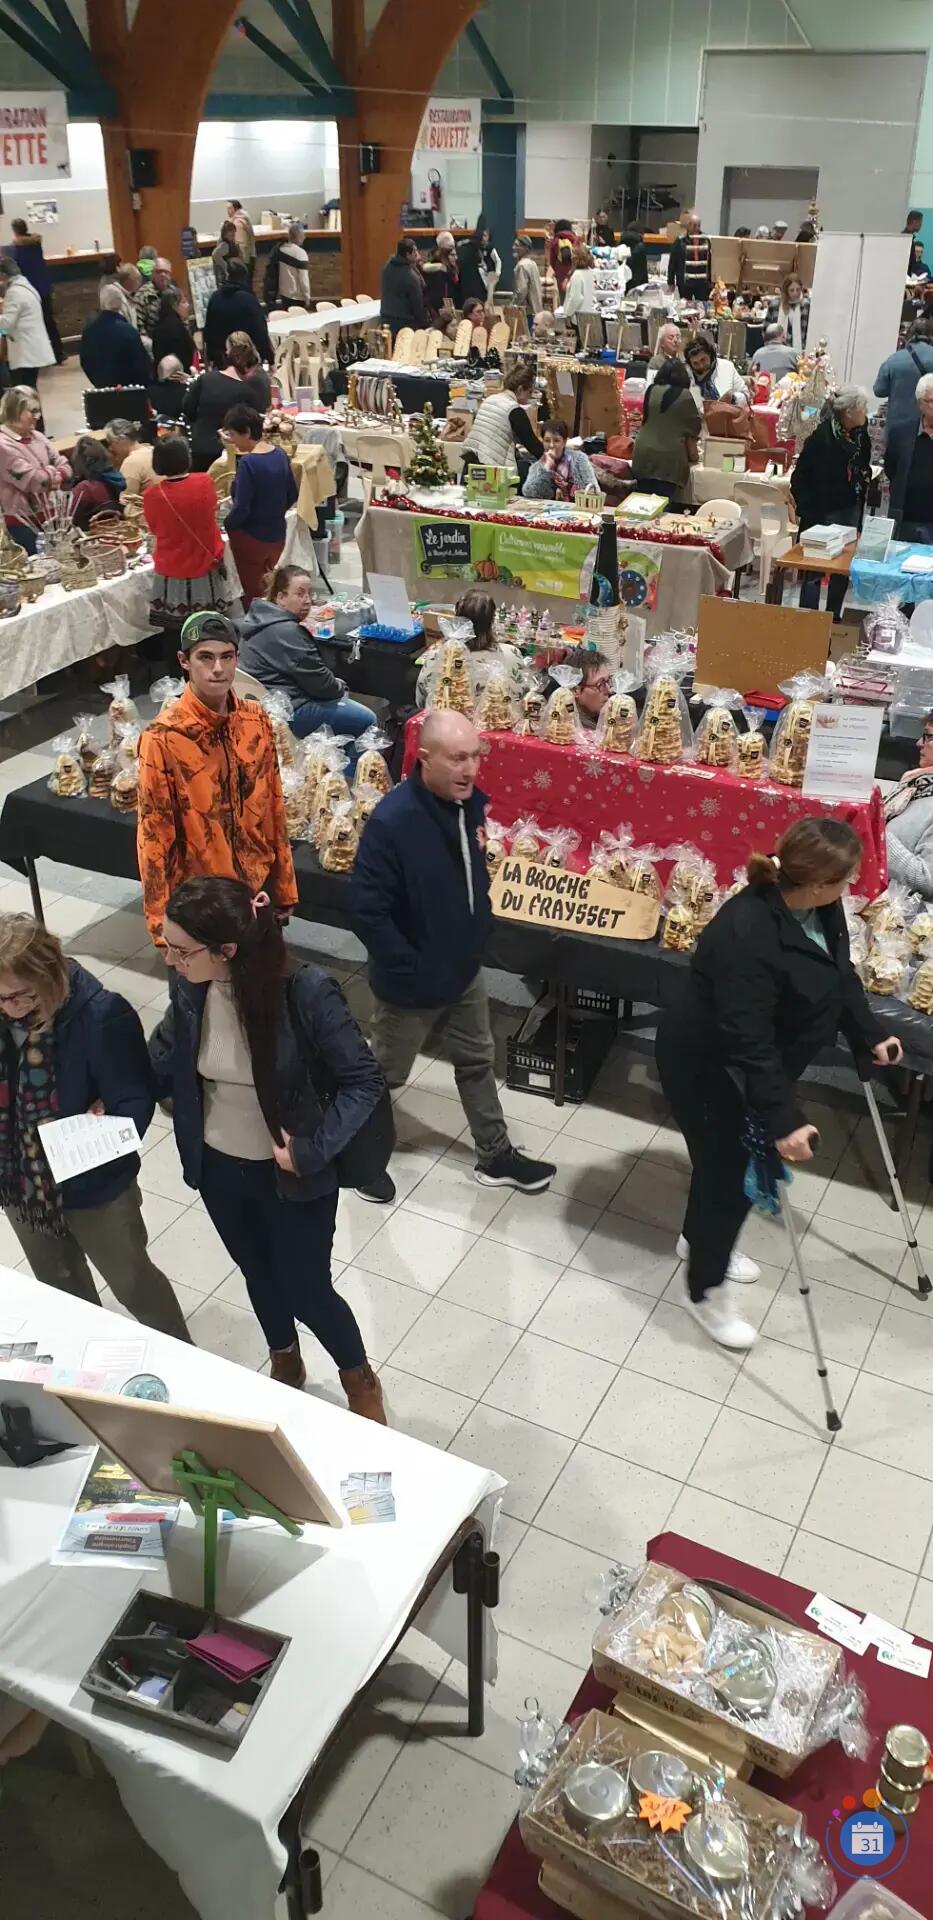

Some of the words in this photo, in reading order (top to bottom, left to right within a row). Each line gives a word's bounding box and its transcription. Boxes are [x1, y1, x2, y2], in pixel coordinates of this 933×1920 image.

[429, 109, 471, 123] RESTAURATION
[429, 127, 470, 148] BUVETTE
[425, 529, 439, 545] Le
[437, 529, 468, 549] jardin
[502, 862, 522, 884] LA
[525, 866, 591, 899] BROCHE
[501, 889, 524, 912] DU
[528, 893, 626, 929] FRAYSSET
